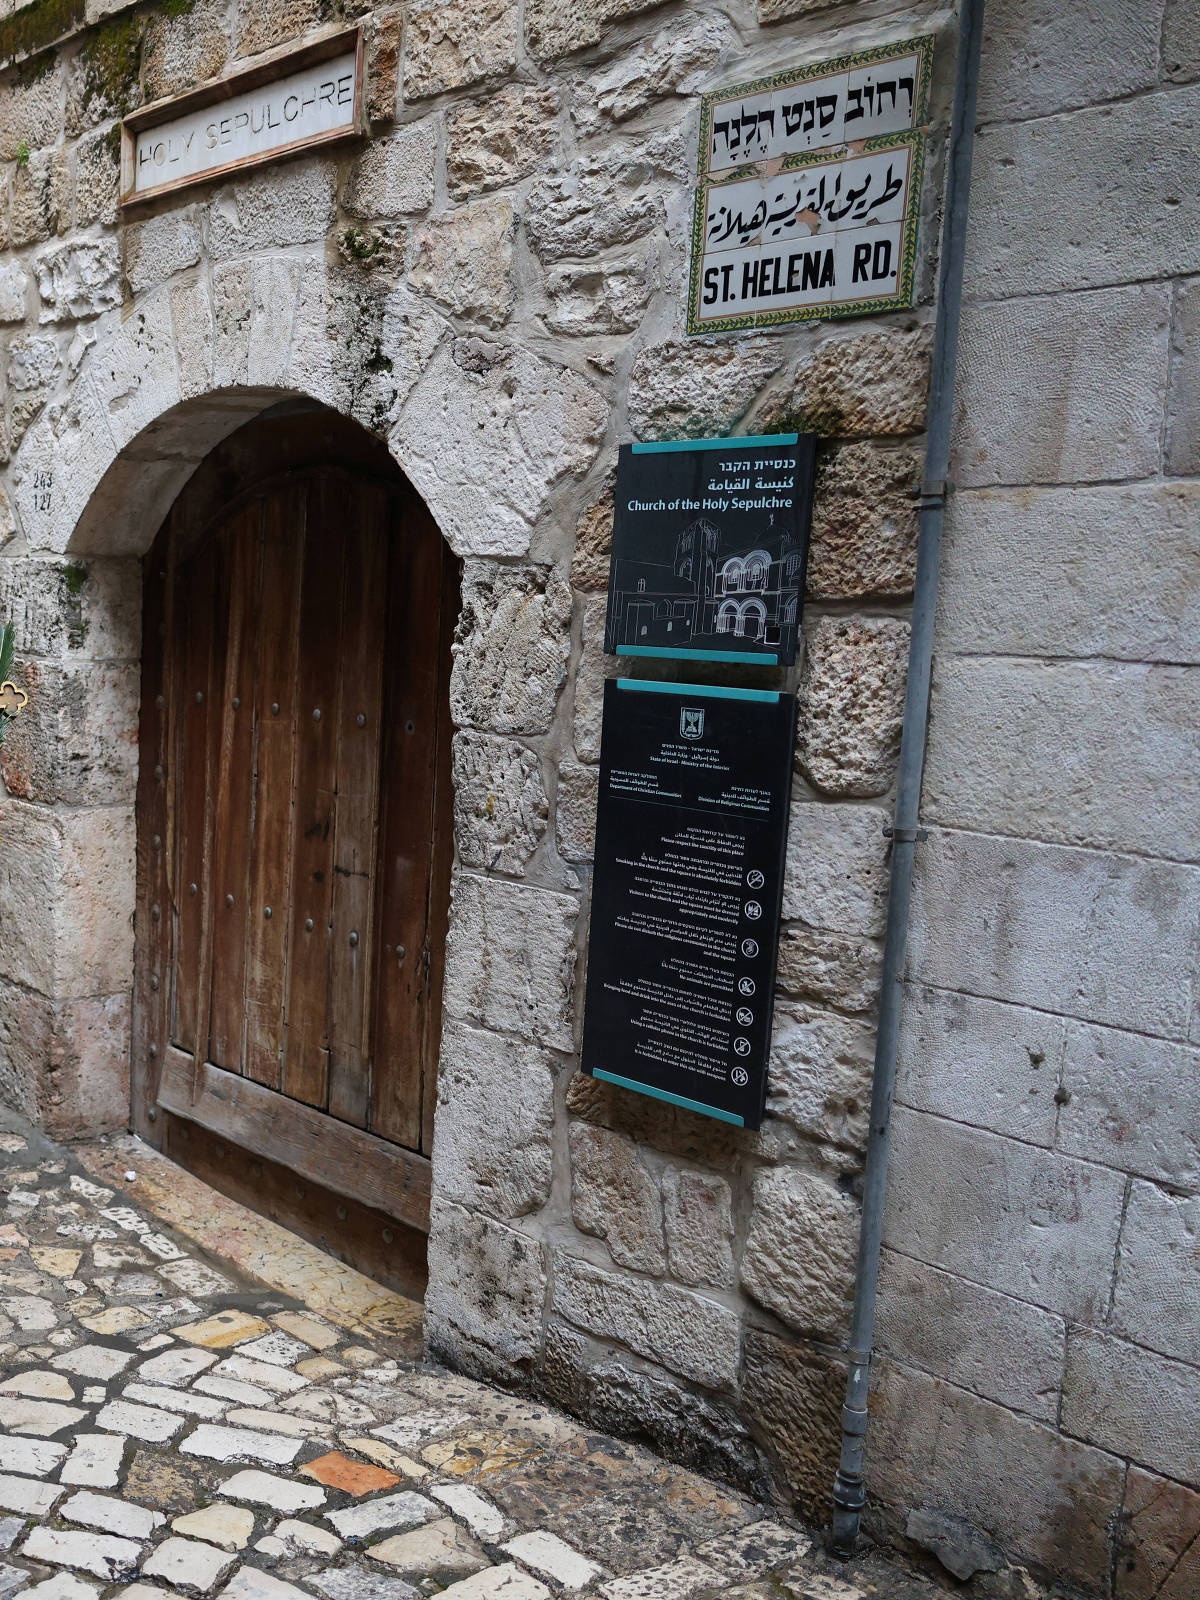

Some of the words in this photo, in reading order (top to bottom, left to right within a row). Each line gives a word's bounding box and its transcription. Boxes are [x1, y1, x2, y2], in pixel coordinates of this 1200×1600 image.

[139, 130, 195, 167] HOLY
[206, 75, 352, 149] SEPULCHRE
[703, 264, 737, 305] ST.
[741, 248, 836, 300] HELENA
[852, 239, 897, 283] RD.
[719, 461, 751, 473] הקבר
[754, 459, 796, 470] כנסיית
[708, 478, 750, 493] القيامة
[754, 476, 794, 492] كنيسة
[628, 499, 666, 511] Church
[668, 499, 680, 510] of
[681, 499, 700, 510] the
[702, 498, 729, 513] Holy
[731, 496, 793, 512] Sepulchre
